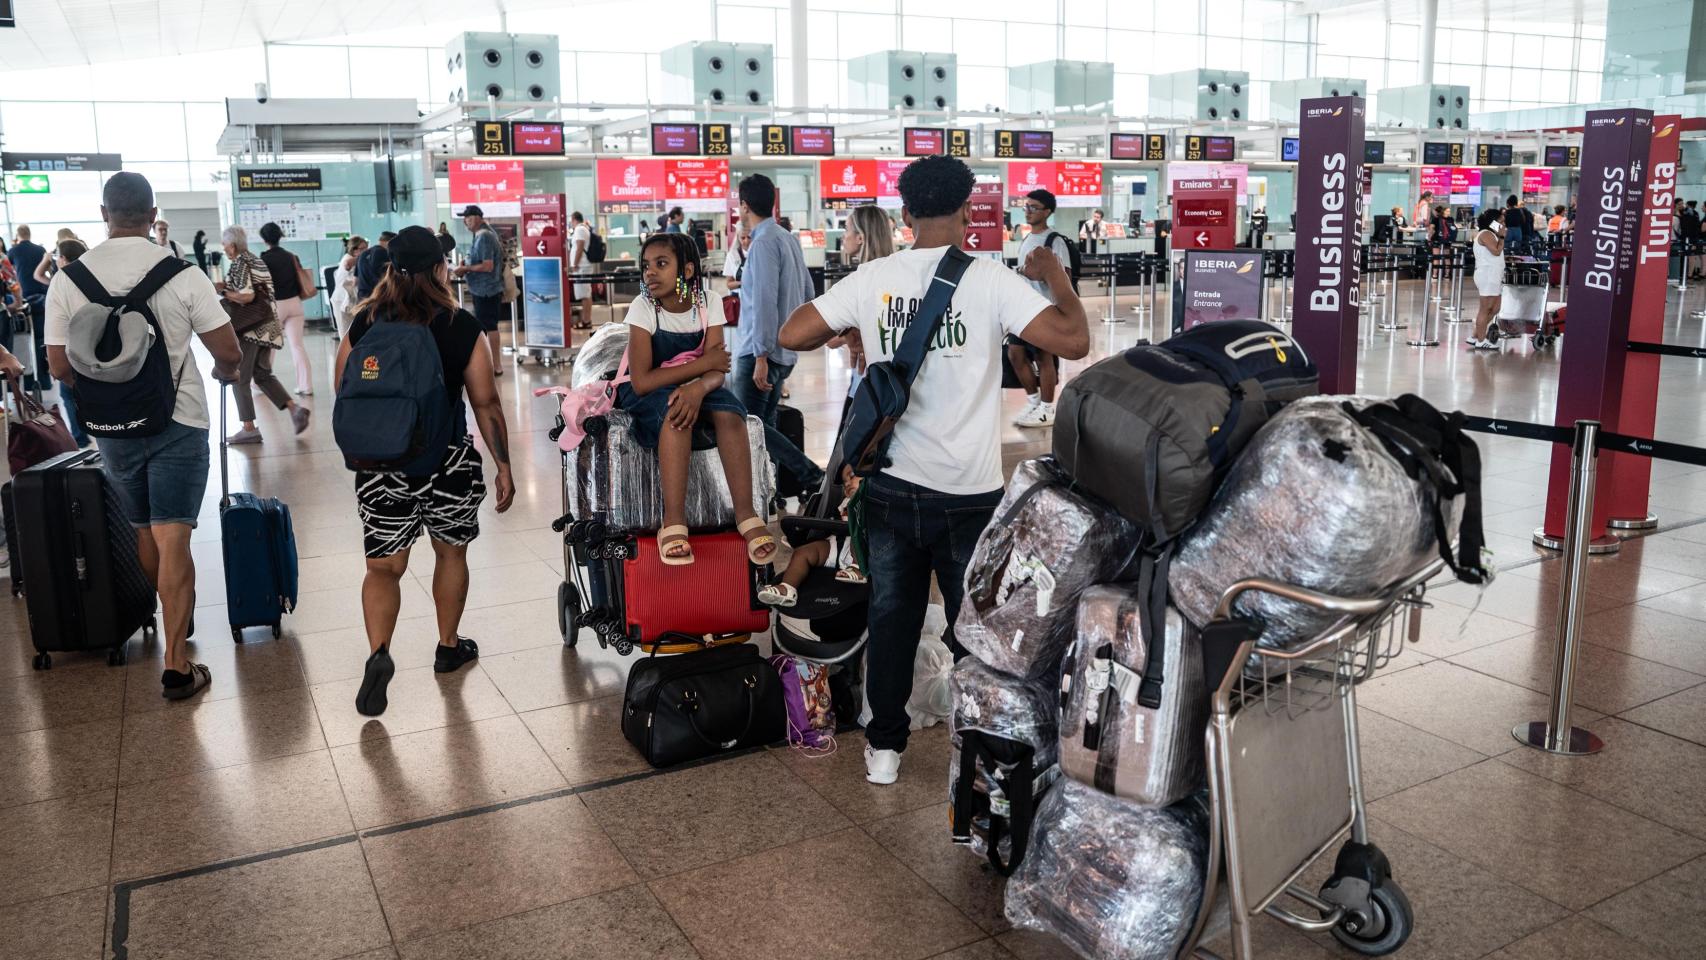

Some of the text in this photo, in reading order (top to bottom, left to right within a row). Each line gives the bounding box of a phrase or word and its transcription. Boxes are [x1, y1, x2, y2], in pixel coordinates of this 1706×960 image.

[483, 142, 505, 154] 251
[708, 143, 729, 154] 252
[766, 143, 786, 154] 253
[950, 146, 968, 156] 254
[998, 147, 1014, 157] 255
[1148, 150, 1163, 159] 256
[1187, 151, 1202, 160] 257
[461, 162, 497, 171] Emirates
[831, 184, 867, 193] Emirates
[1179, 180, 1212, 188] Emirates
[611, 185, 653, 196] Emirates
[1184, 209, 1209, 217] Economy
[1640, 161, 1676, 265] Turista
[1310, 152, 1346, 312] Business
[1584, 166, 1625, 292] Business
[1349, 164, 1365, 308] Business
[1195, 260, 1238, 269] IBERIA
[1193, 290, 1221, 298] Entrada
[888, 295, 904, 313] LO
[1193, 299, 1223, 308] Entrance
[86, 421, 125, 431] Reebok
